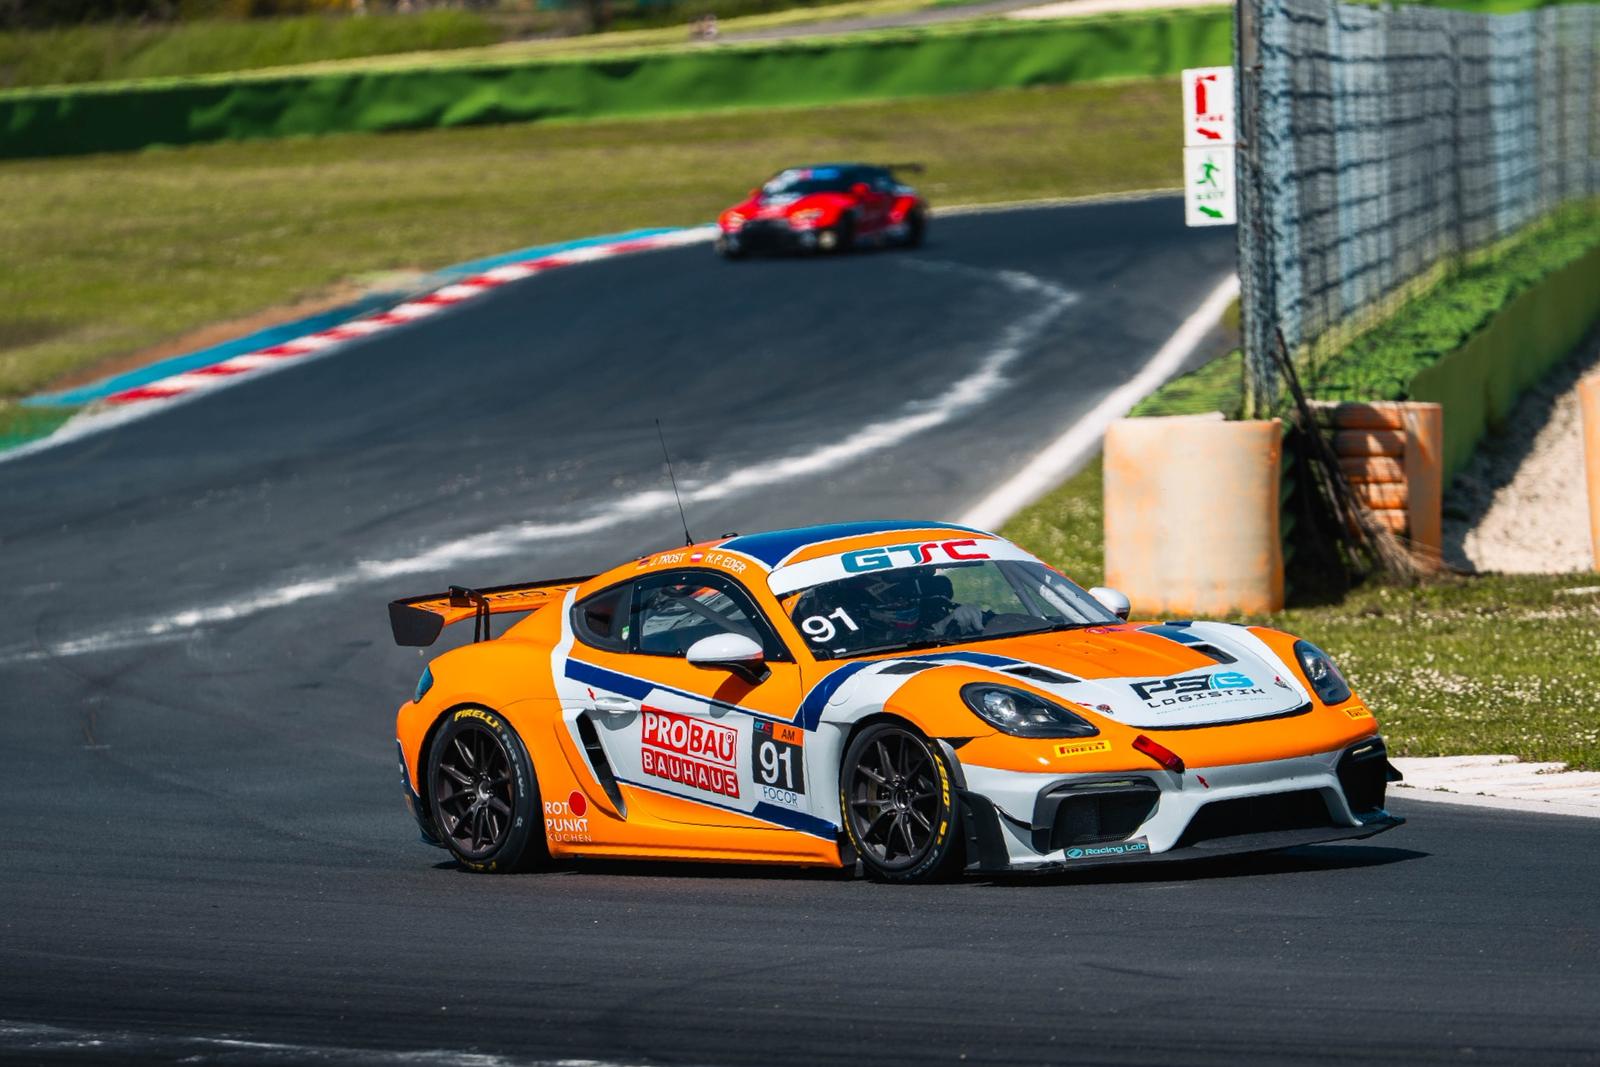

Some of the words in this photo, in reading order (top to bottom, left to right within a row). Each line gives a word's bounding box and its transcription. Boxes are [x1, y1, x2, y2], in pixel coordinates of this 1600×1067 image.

[657, 553, 687, 565] TROST
[722, 556, 747, 574] EDER
[841, 540, 990, 573] GTC
[802, 607, 859, 643] 91
[1147, 688, 1266, 708] LOGISTIK
[454, 709, 499, 728] PIRELLI
[781, 729, 796, 741] AM
[1059, 742, 1106, 755] PIRELLI
[643, 752, 737, 793] BAUHAUS
[759, 741, 794, 789] 91
[763, 786, 798, 807] FOCOR
[545, 801, 568, 815] ROT
[546, 818, 588, 832] PUNKT
[1085, 845, 1124, 856] Racing
[1125, 842, 1147, 852] Lab
